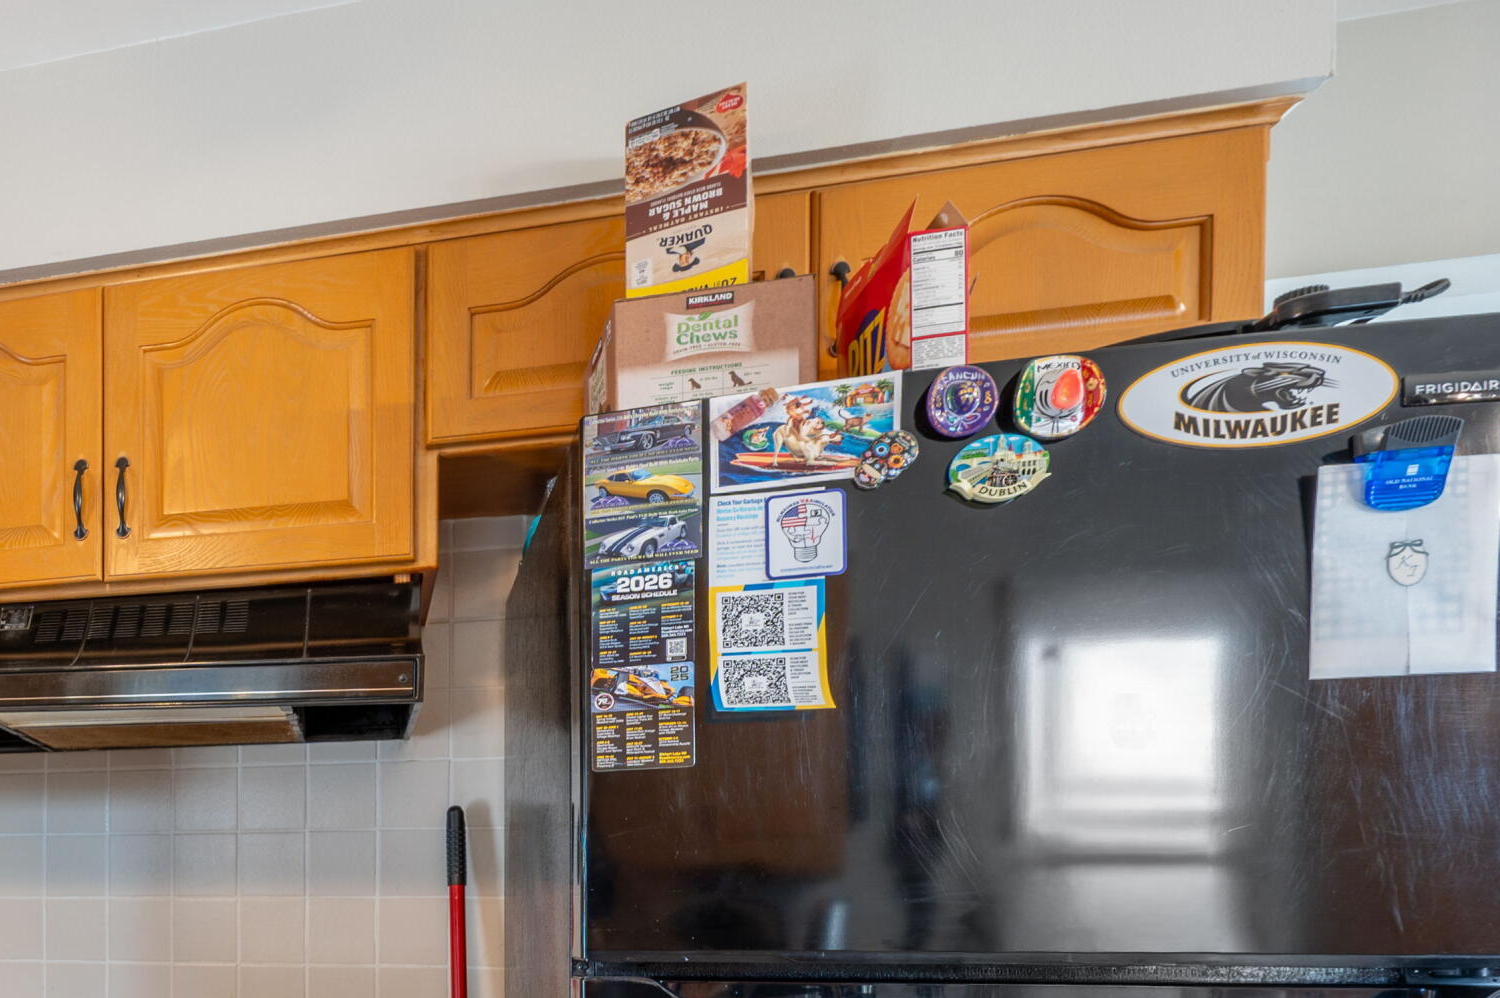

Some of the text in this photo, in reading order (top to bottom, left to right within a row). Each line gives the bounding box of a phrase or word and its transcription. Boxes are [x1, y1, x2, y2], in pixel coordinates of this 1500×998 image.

[648, 187, 723, 217] BROWN SUGAR
[672, 200, 709, 216] MAPLE
[659, 224, 713, 247] QUAKER
[912, 230, 963, 243] Nutrition Facts
[913, 255, 936, 263] Calories
[688, 292, 733, 305] KIRKLAND
[676, 314, 739, 334] Dental
[676, 329, 739, 345] Chews
[848, 306, 887, 377] RITZ
[698, 362, 742, 372] INSTRUCTIONS
[1171, 350, 1342, 378] UNIVERSITY of WISCONSIN
[943, 371, 986, 384] CANCUN
[1173, 402, 1341, 440] MILWAUKEE
[978, 482, 1028, 497] DUBLIN
[611, 564, 680, 577] ROAD AMERICA
[616, 572, 673, 594] 2026
[611, 589, 678, 602] SEASON SCHEDULE
